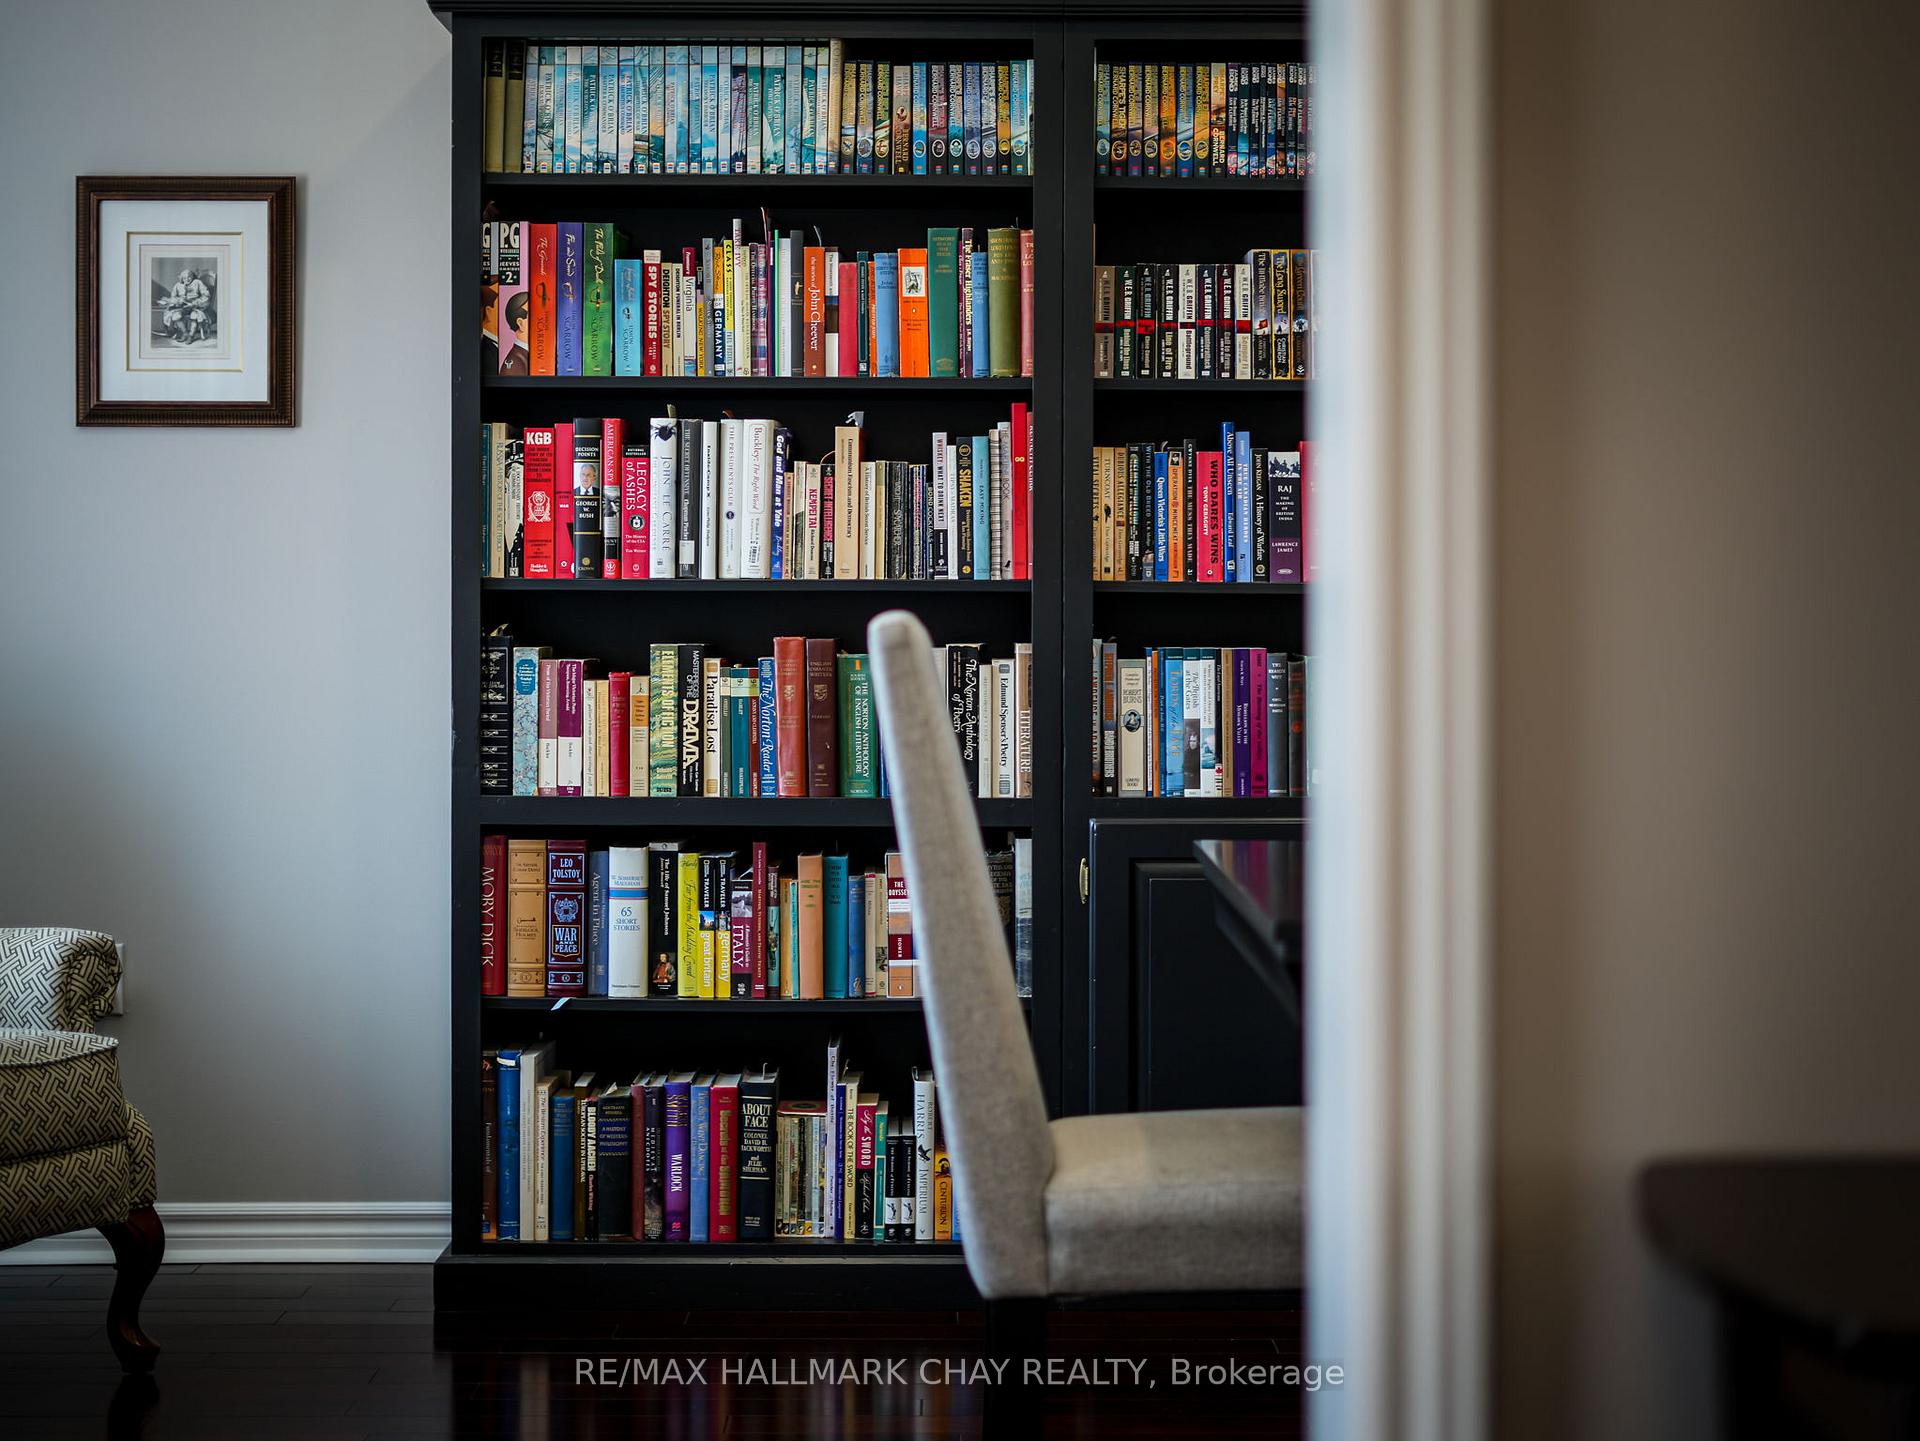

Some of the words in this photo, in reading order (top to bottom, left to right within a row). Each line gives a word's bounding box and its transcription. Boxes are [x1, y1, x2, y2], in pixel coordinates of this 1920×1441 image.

[965, 240, 973, 252] The
[505, 272, 514, 283] 2
[648, 265, 658, 288] SPY
[965, 254, 973, 278] Fraser
[662, 269, 670, 308] DEIGHTON
[684, 278, 695, 312] Virginia
[808, 287, 821, 310] John
[648, 291, 658, 339] STORIES
[965, 280, 973, 325] Highlanders
[662, 310, 670, 324] SPY
[563, 317, 572, 360] SCARROW
[590, 317, 599, 361] SCARROW
[662, 325, 670, 349] STORY
[714, 310, 722, 360] GERMANY
[810, 311, 821, 350] Cheever
[527, 432, 552, 445] KGB
[775, 435, 785, 453] God
[626, 462, 635, 471] of
[775, 456, 784, 472] and
[1210, 460, 1218, 487] WHO
[1254, 454, 1262, 469] JOHN
[637, 462, 648, 512] LEGACY
[774, 475, 783, 494] Man
[960, 469, 972, 507] SHAKEN
[1002, 478, 1010, 502] BOOK
[1103, 458, 1112, 500] TURNCOAT
[1157, 477, 1165, 498] Queen
[1277, 485, 1293, 494] RAJ
[626, 473, 635, 511] ASHES
[774, 497, 782, 506] at
[808, 489, 818, 514] KEMPEI
[773, 509, 783, 527] Yale
[808, 517, 818, 528] TAI
[1210, 491, 1218, 530] DARES
[1254, 501, 1265, 526] History
[1157, 528, 1165, 545] Little
[1255, 527, 1264, 536] of
[1157, 546, 1165, 562] Wars
[1210, 535, 1218, 564] WINS
[1256, 536, 1265, 561] Warfare
[662, 651, 675, 696] ELEMENTS
[685, 674, 693, 683] OF
[692, 650, 700, 699] MASTERPIECES
[965, 659, 977, 678] The
[685, 684, 693, 699] THE
[705, 675, 719, 726] Paradise
[762, 679, 774, 698] The
[855, 685, 861, 695] OF
[951, 693, 964, 706] of
[963, 678, 977, 711] Norton
[999, 678, 1008, 707] Edmund
[662, 699, 675, 711] OF
[759, 694, 777, 738] Norton
[662, 713, 675, 748] FICTION
[682, 699, 700, 769] DRAMA
[963, 712, 977, 761] Anthology
[998, 709, 1008, 742] Spenser's
[705, 728, 719, 754] Lost
[1019, 710, 1031, 774] LITERATURE
[760, 739, 774, 774] Reader
[998, 743, 1008, 768] Poetry
[553, 869, 581, 879] TOLSTOY
[560, 858, 573, 868] LEO
[591, 871, 601, 901] Agent
[591, 904, 601, 914] in
[620, 906, 632, 917] 65
[555, 927, 578, 942] WAR
[591, 917, 601, 946] Place
[700, 933, 712, 955] great
[481, 923, 496, 968] DICK
[555, 944, 578, 953] PEACE
[718, 932, 730, 983] germany
[733, 925, 744, 968] ITALY
[700, 957, 712, 988] britain
[742, 1103, 771, 1115] ABOUT
[745, 1115, 769, 1128] FACE
[916, 1094, 926, 1139] HARRIS
[587, 1106, 597, 1138] BLOODY
[587, 1140, 597, 1172] AACHEN
[847, 1141, 854, 1149] OF
[861, 1136, 872, 1166] SWORD
[671, 1154, 683, 1193] WARLOCK
[919, 1169, 928, 1215] IMPERIUM
[938, 1181, 948, 1225] CENTURION
